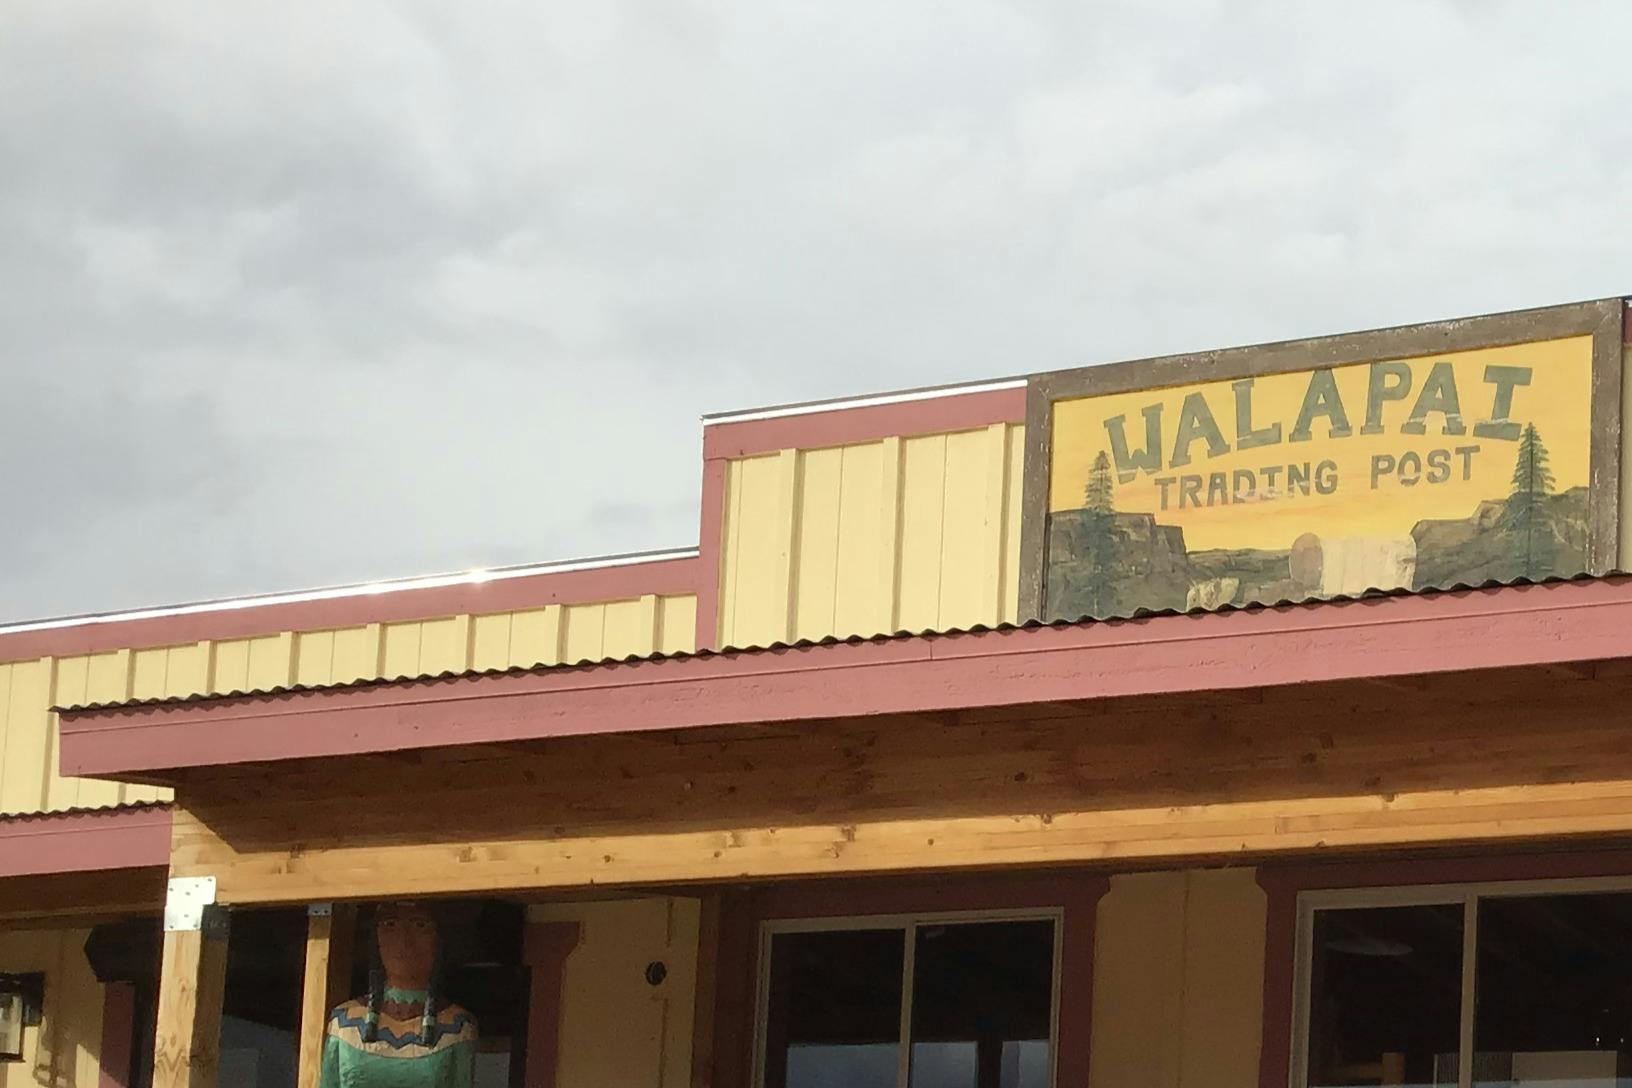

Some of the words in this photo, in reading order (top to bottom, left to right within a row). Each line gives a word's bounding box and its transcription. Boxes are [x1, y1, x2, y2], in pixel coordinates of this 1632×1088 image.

[1104, 362, 1533, 484] WALAPAI
[1154, 459, 1339, 511] TRADING
[1371, 445, 1481, 489] POST
